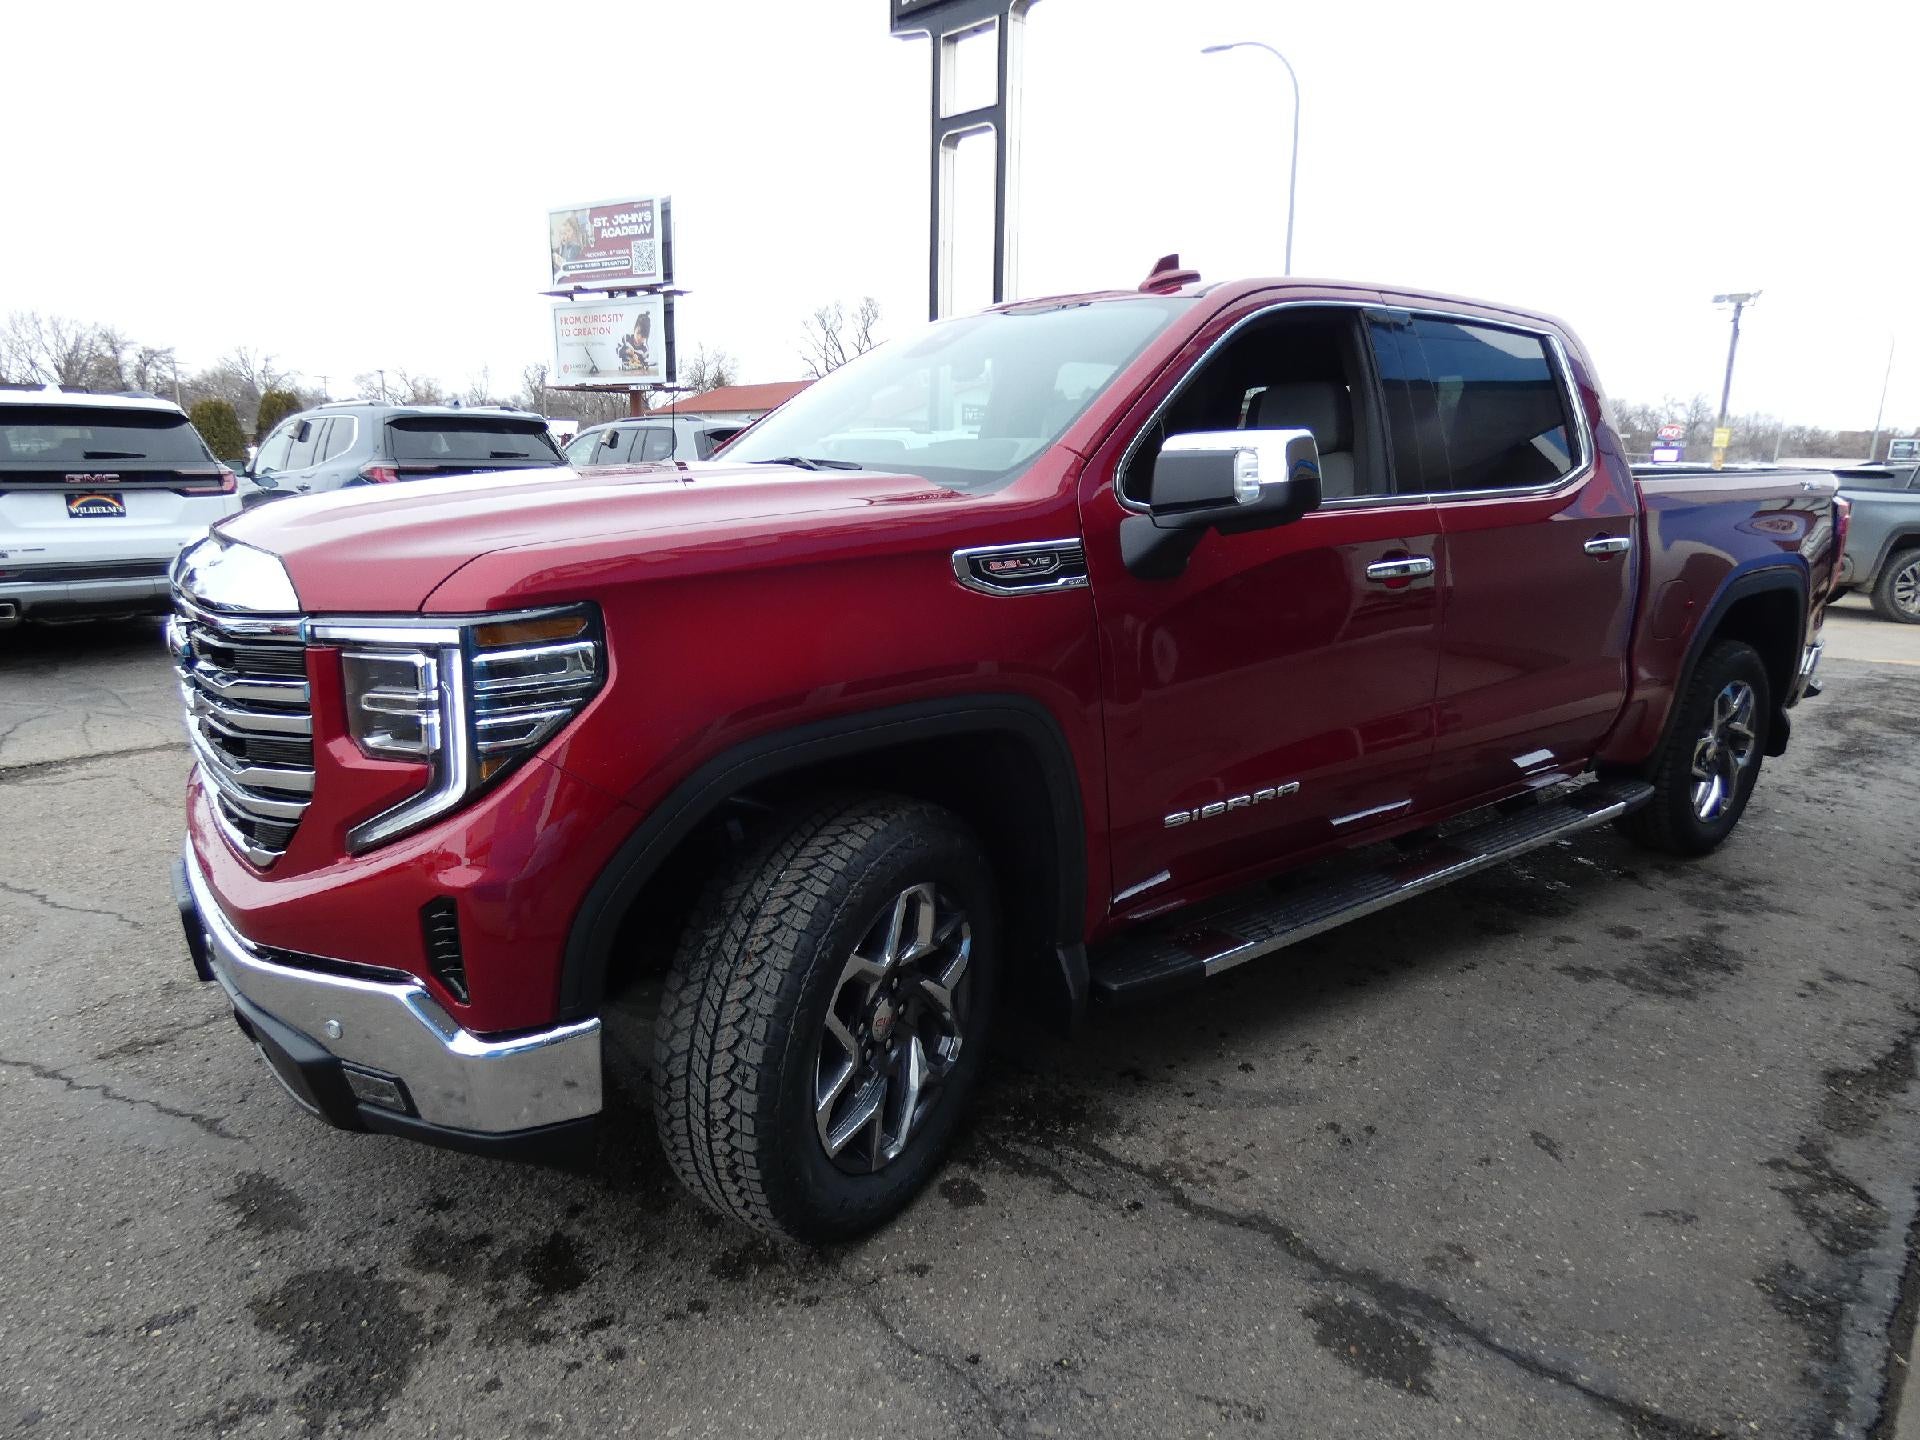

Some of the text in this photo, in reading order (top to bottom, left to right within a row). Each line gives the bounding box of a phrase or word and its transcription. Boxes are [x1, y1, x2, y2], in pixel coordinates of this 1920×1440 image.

[593, 210, 652, 228] ST. JOHN'S
[601, 223, 652, 239] ACADEMY
[560, 313, 624, 326] FROM CURIOSITY
[560, 326, 611, 337] TO CREATION
[65, 473, 120, 483] GMC
[68, 505, 127, 514] WILHELM'S
[1164, 781, 1300, 828] SIERRA
